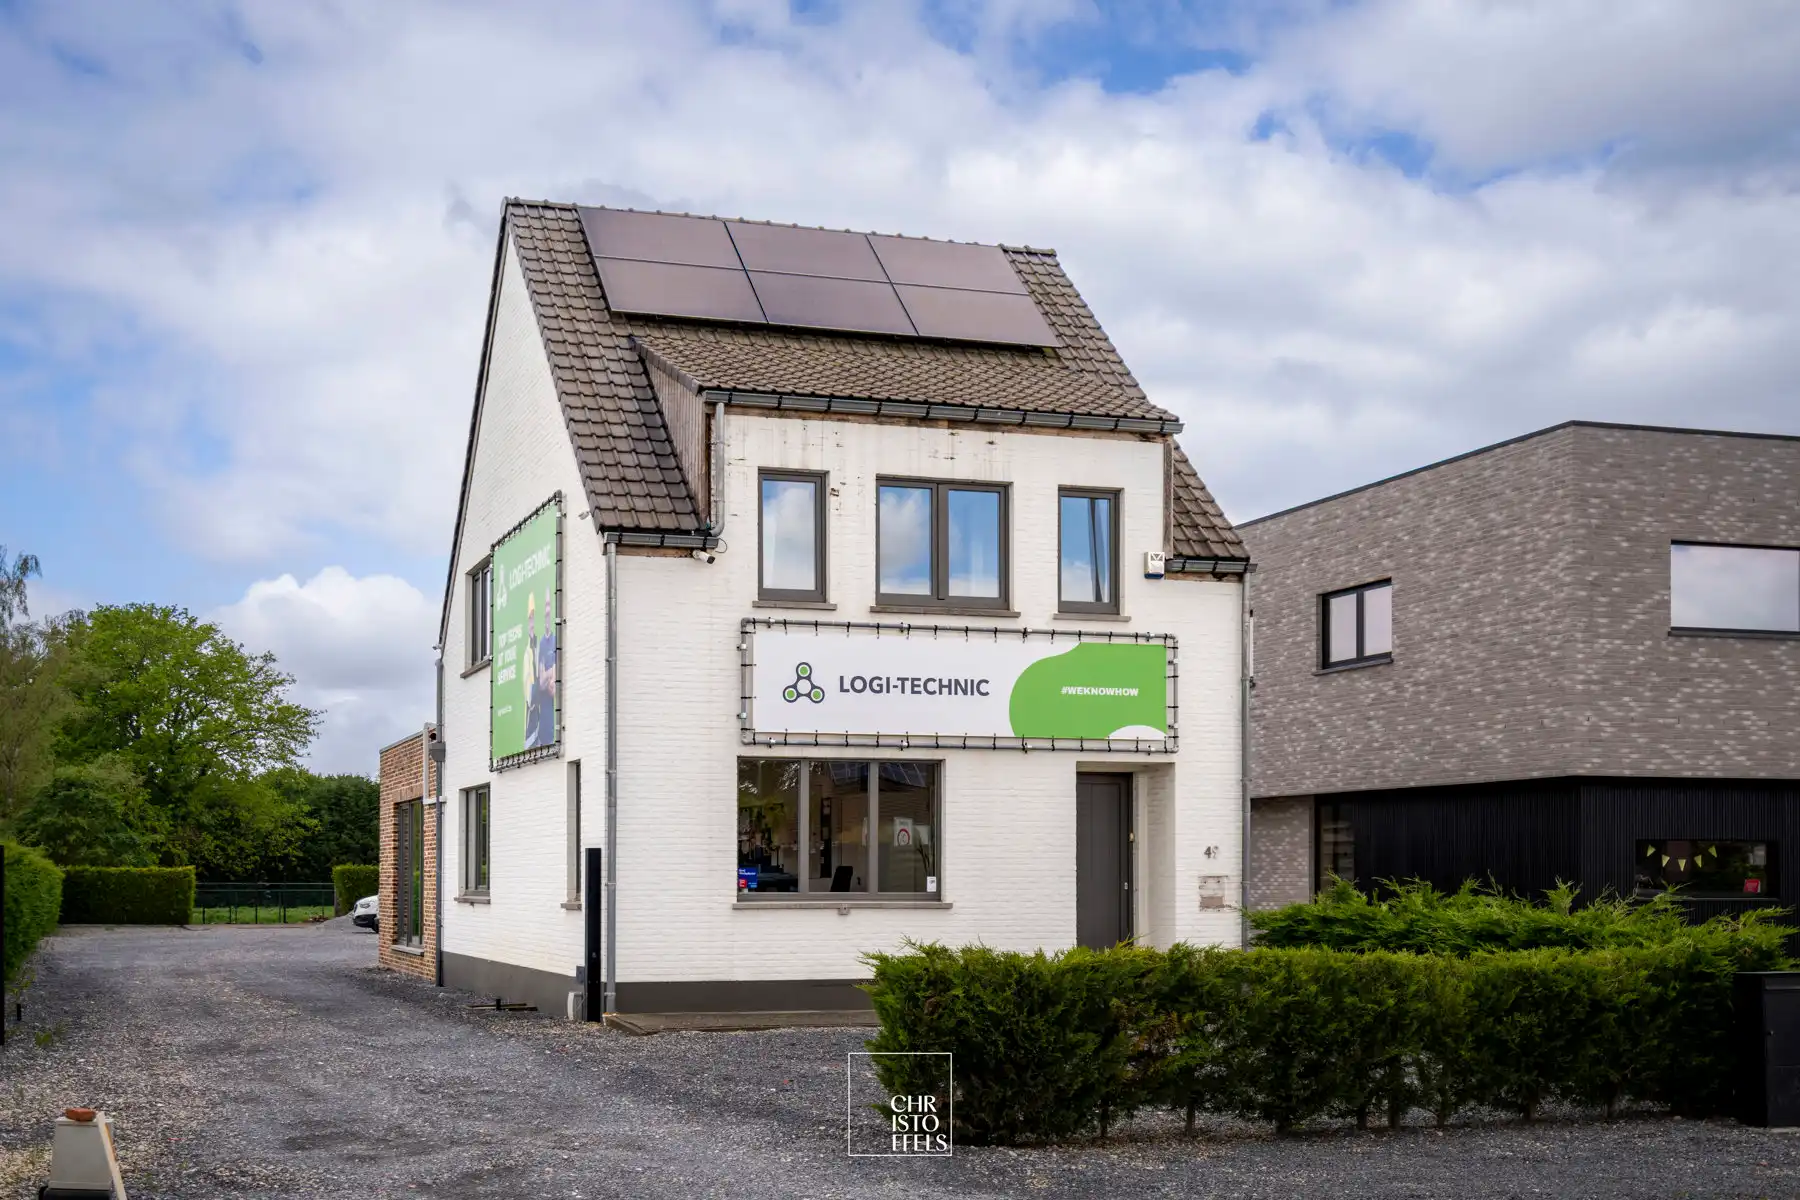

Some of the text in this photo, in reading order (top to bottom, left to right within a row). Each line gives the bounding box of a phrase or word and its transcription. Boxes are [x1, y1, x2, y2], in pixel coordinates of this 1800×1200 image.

[509, 545, 551, 590] LOGI-TECHNIC
[839, 675, 990, 697] LOGI-TECHNIC
[1060, 686, 1139, 697] #WEKNOWHOW
